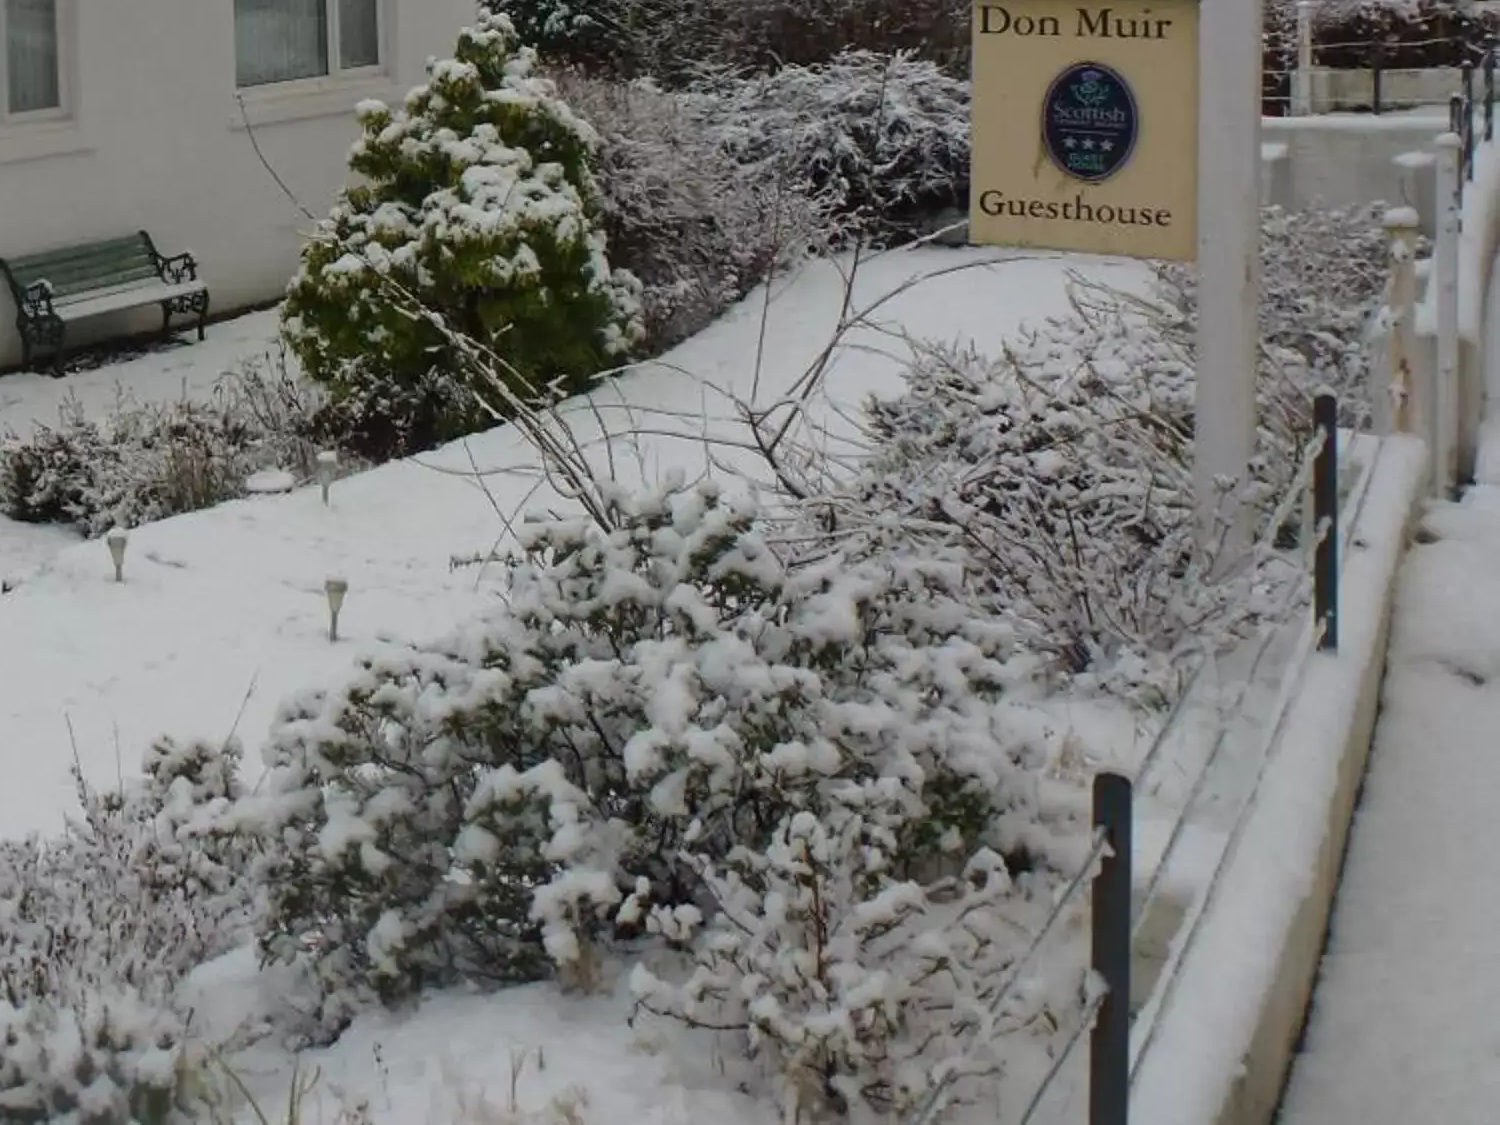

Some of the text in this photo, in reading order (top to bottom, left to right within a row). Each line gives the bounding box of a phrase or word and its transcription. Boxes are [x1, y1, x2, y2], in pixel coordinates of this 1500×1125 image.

[979, 4, 1172, 39] Don Muir
[1053, 102, 1126, 122] Scottish
[979, 190, 1172, 227] Guesthouse
